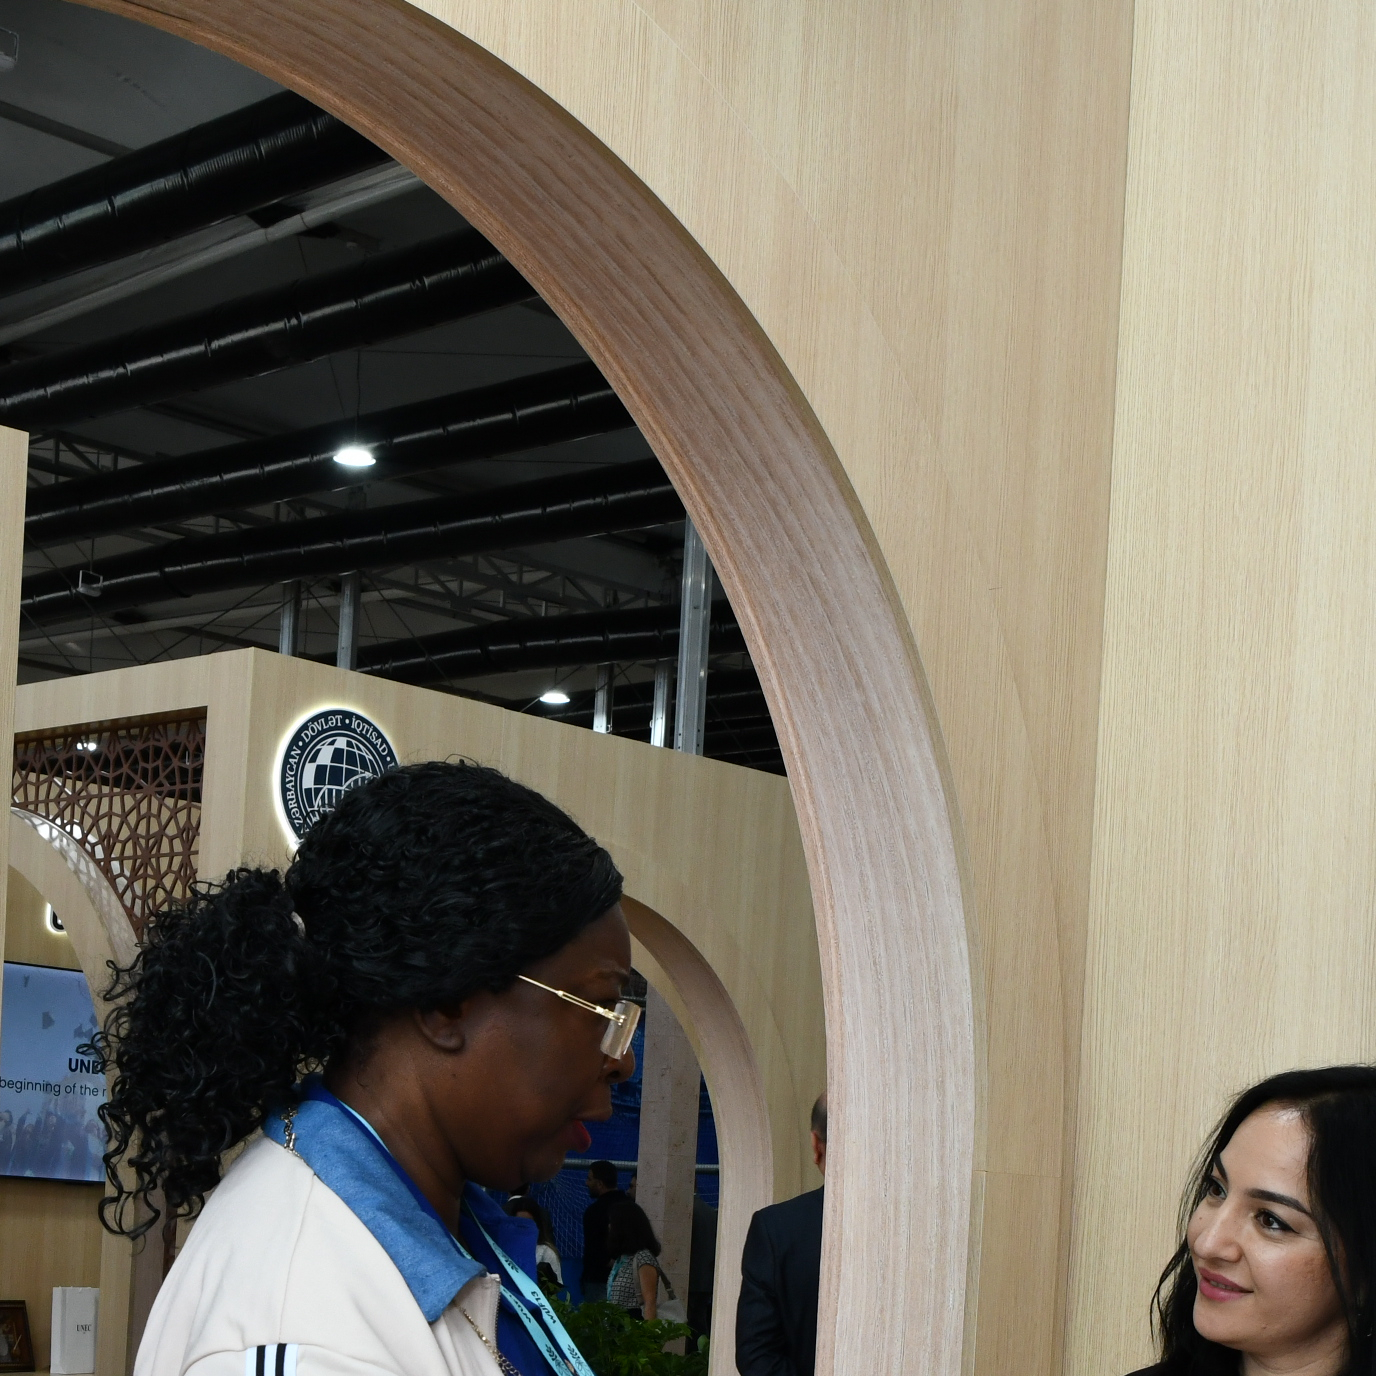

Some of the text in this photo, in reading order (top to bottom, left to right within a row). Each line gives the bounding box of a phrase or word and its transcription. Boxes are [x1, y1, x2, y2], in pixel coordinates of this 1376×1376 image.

[286, 746, 308, 833] ZƏRBAYCAN
[0, 1076, 61, 1096] beginning
[65, 1083, 76, 1094] of
[80, 1085, 98, 1097] the
[531, 1291, 556, 1323] WUF13
